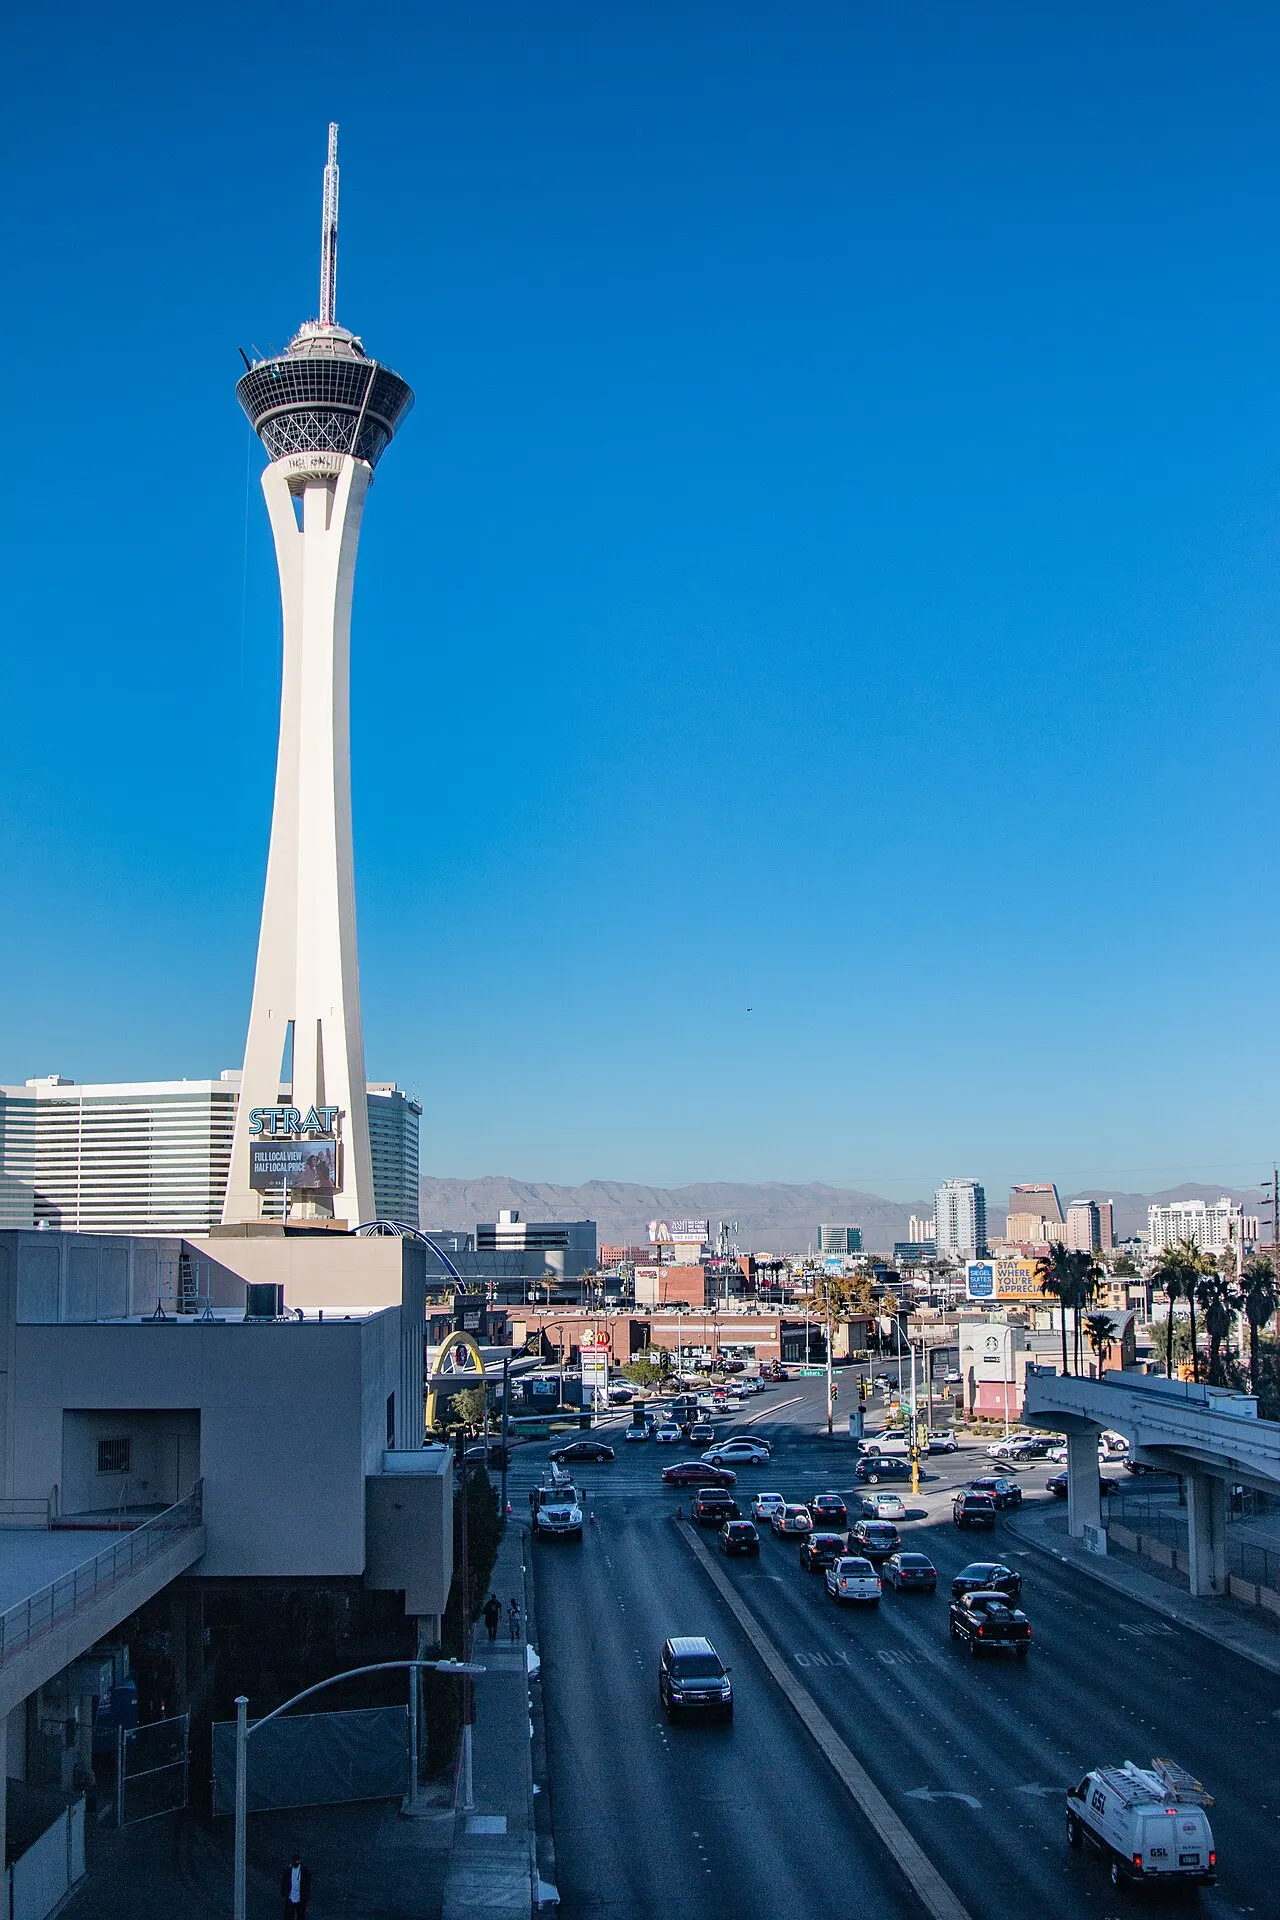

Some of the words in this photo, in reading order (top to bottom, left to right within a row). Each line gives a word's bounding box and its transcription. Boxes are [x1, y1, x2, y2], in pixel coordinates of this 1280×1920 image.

[249, 1105, 339, 1134] STRAT
[254, 1152, 268, 1161] FULL
[269, 1152, 286, 1161] LOCAL
[287, 1152, 302, 1161] VIEW
[254, 1163, 269, 1172] HALF
[270, 1163, 287, 1172] LOCAL
[288, 1162, 306, 1171] PRICE
[997, 1261, 1019, 1269] STAY
[997, 1269, 1030, 1277] WHERE
[997, 1277, 1032, 1285] YOU'RE
[997, 1285, 1044, 1293] APPRECIA
[794, 1651, 851, 1667] ONLY
[1091, 1788, 1106, 1815] GSL
[1150, 1847, 1169, 1857] GSL
